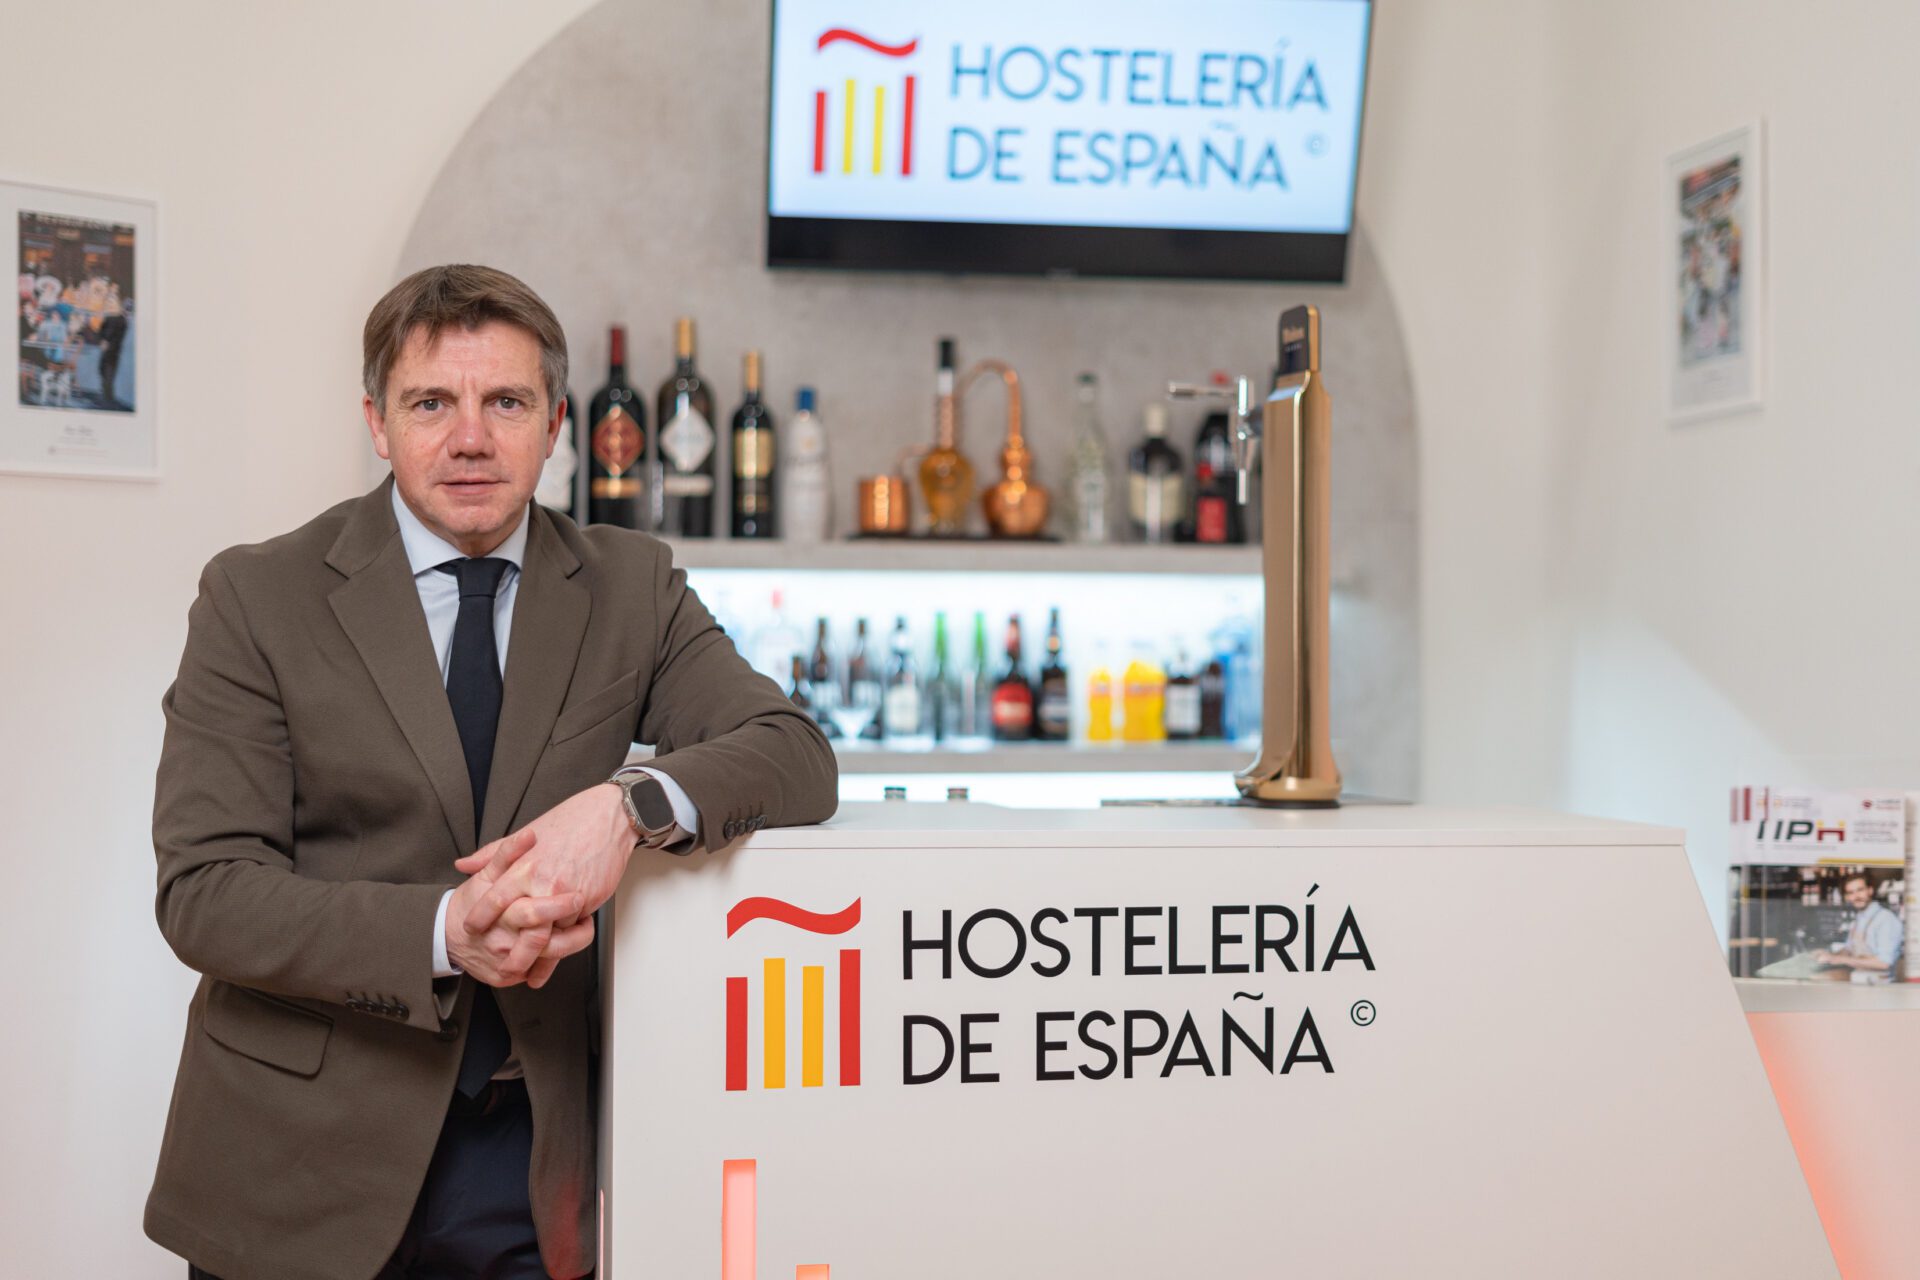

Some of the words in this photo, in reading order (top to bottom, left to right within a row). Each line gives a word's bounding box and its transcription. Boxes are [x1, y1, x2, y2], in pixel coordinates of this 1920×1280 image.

[950, 37, 1330, 111] HOSTELERÍA
[947, 126, 1024, 182] DE
[1051, 120, 1289, 190] ESPAÑA
[902, 883, 1376, 980] HOSTELERÍA
[902, 1012, 1000, 1085] DE
[1035, 991, 1335, 1081] ESPAÑA
